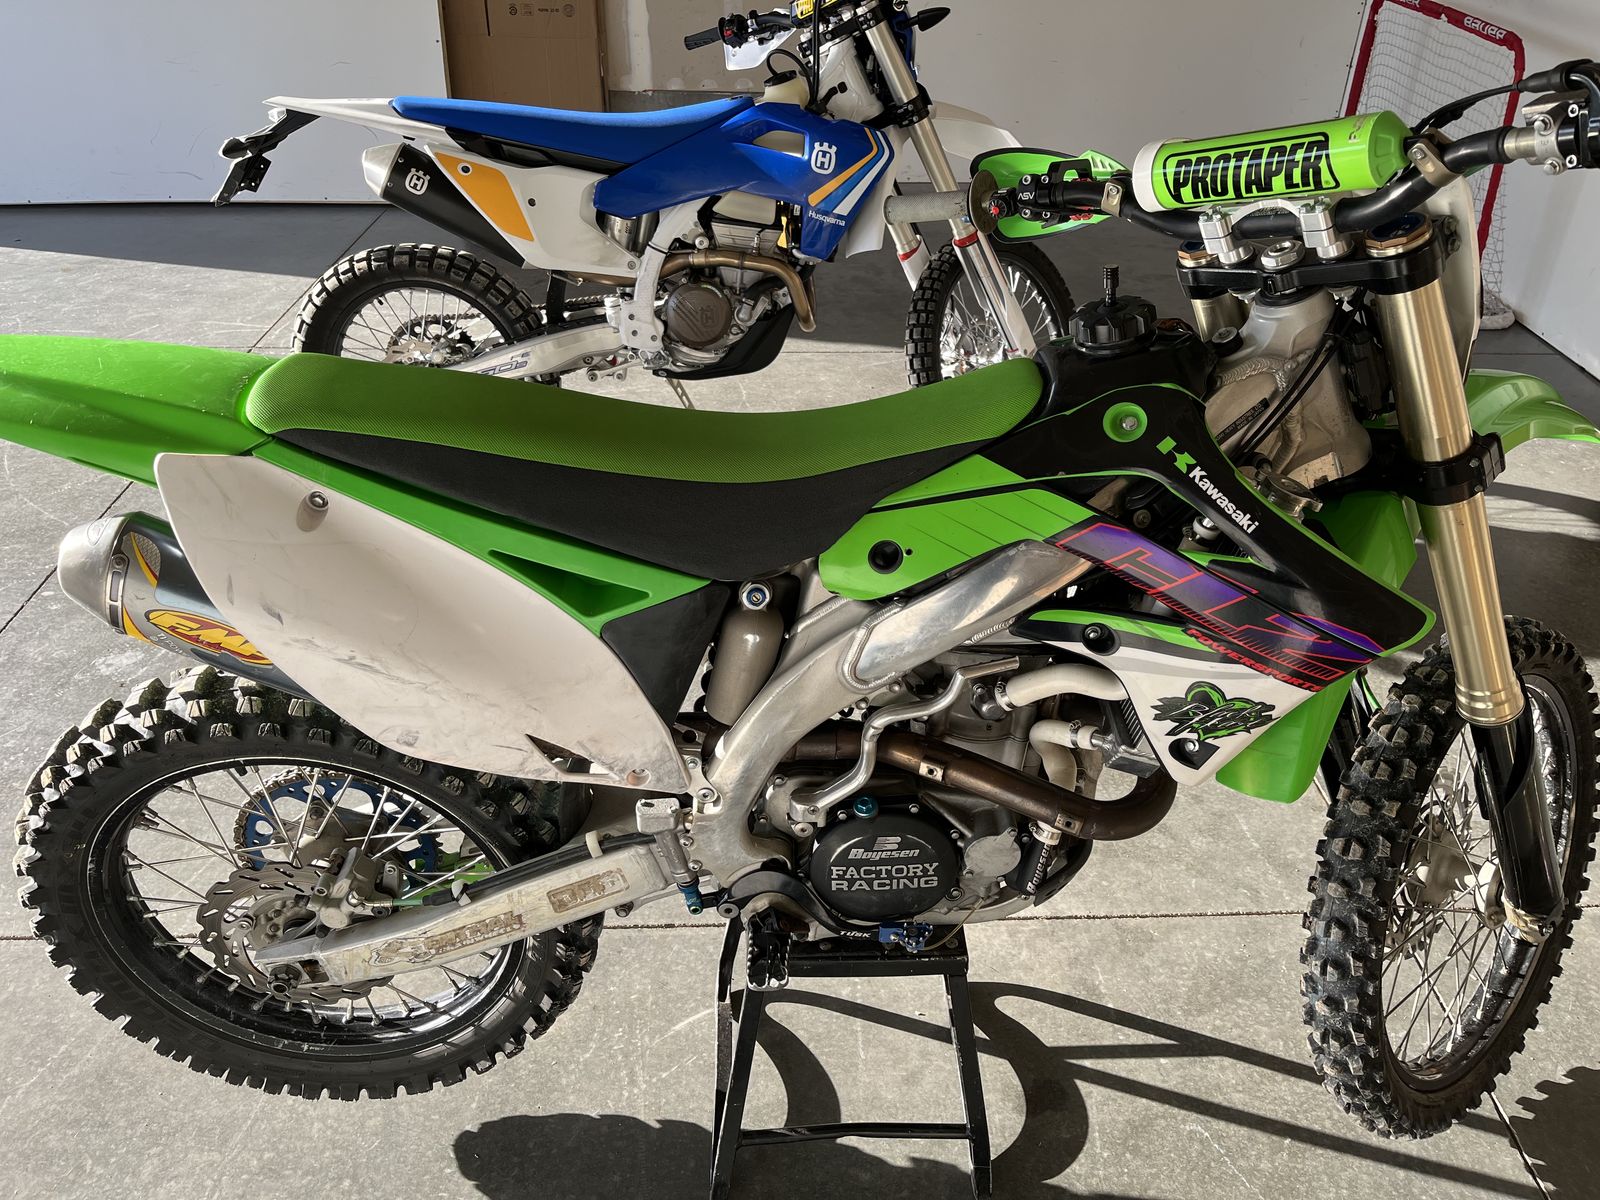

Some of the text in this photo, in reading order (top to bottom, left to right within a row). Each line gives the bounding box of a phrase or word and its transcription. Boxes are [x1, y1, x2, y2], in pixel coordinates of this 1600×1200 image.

[1172, 140, 1325, 200] PROTAPER
[1018, 191, 1035, 200] ASV
[808, 209, 846, 227] Husqvarna
[1188, 465, 1260, 534] Kawasaki
[1186, 628, 1326, 693] POWERSPORTS
[848, 848, 920, 861] Boyesen
[831, 862, 939, 879] FACTORY
[1025, 843, 1051, 895] Boyesen
[831, 877, 938, 891] RACING
